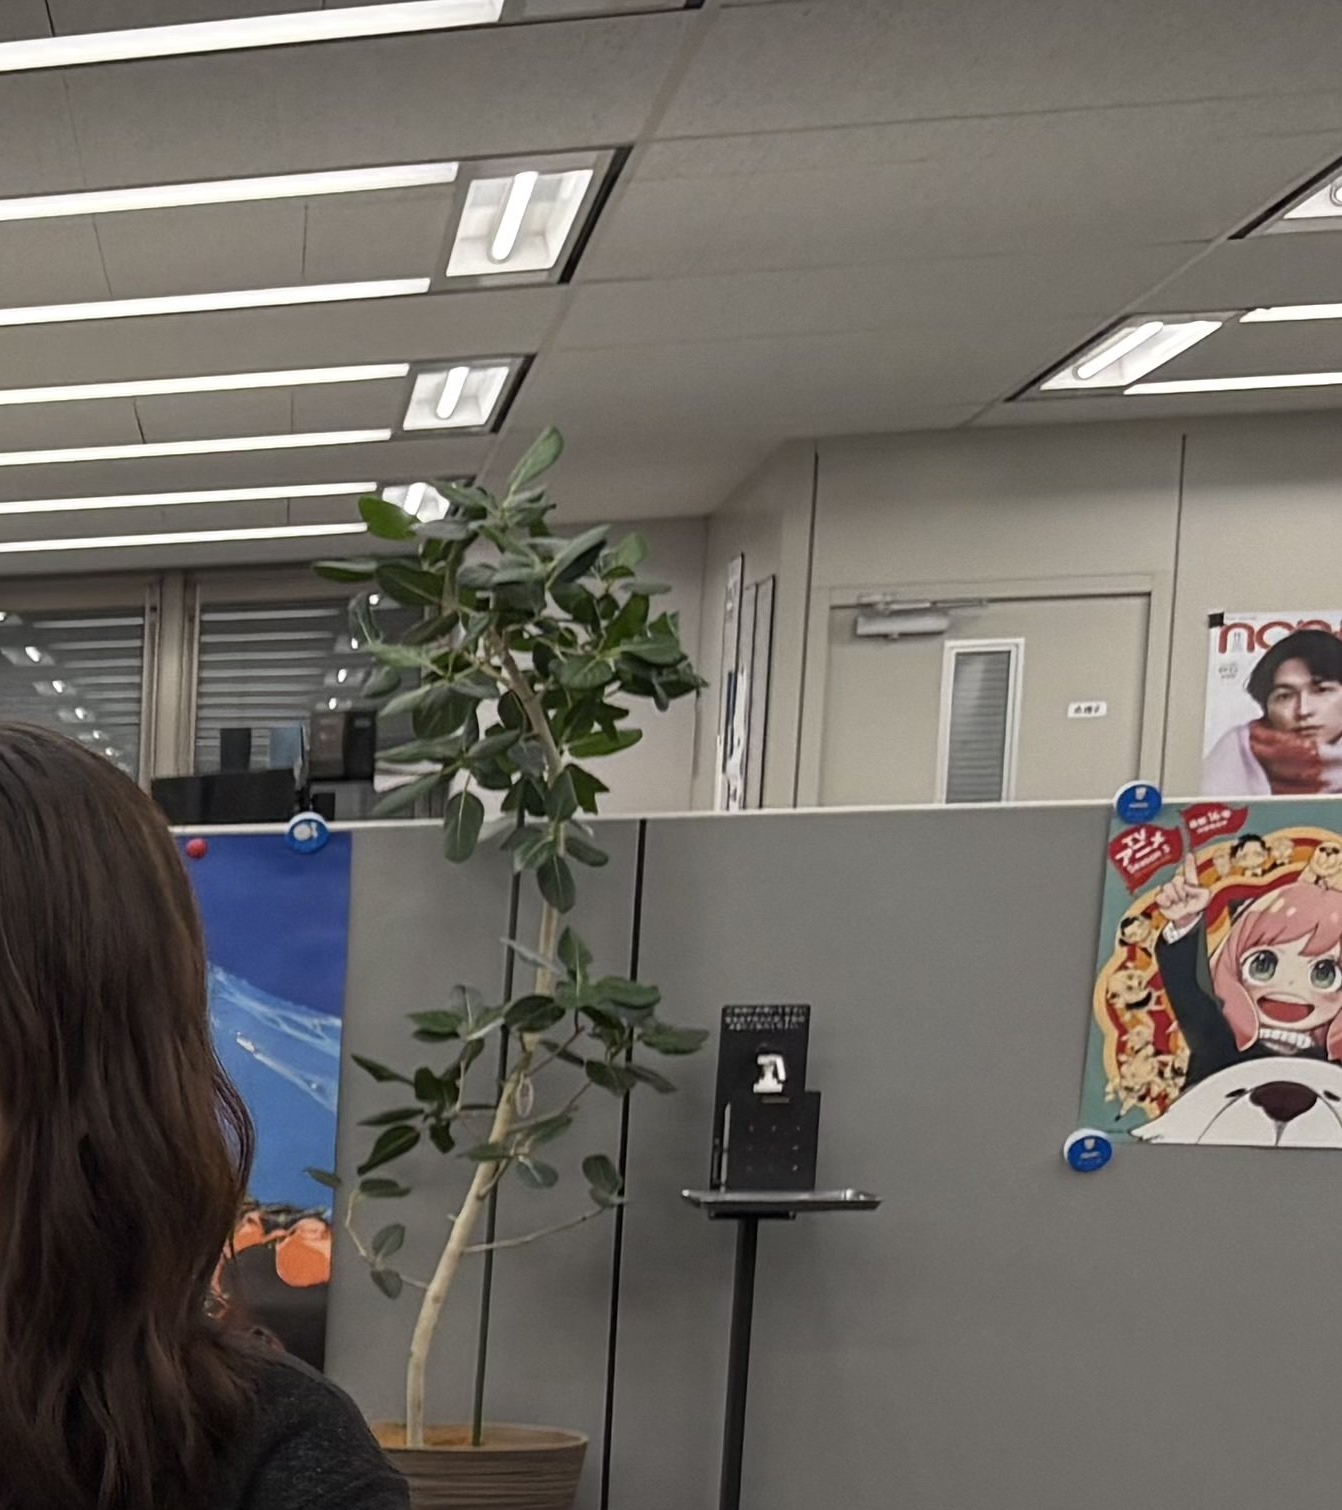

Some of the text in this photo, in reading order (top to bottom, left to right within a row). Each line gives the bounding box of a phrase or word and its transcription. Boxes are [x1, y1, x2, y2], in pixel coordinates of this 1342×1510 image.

[1114, 830, 1165, 867] アニメ
[1121, 827, 1146, 847] TV
